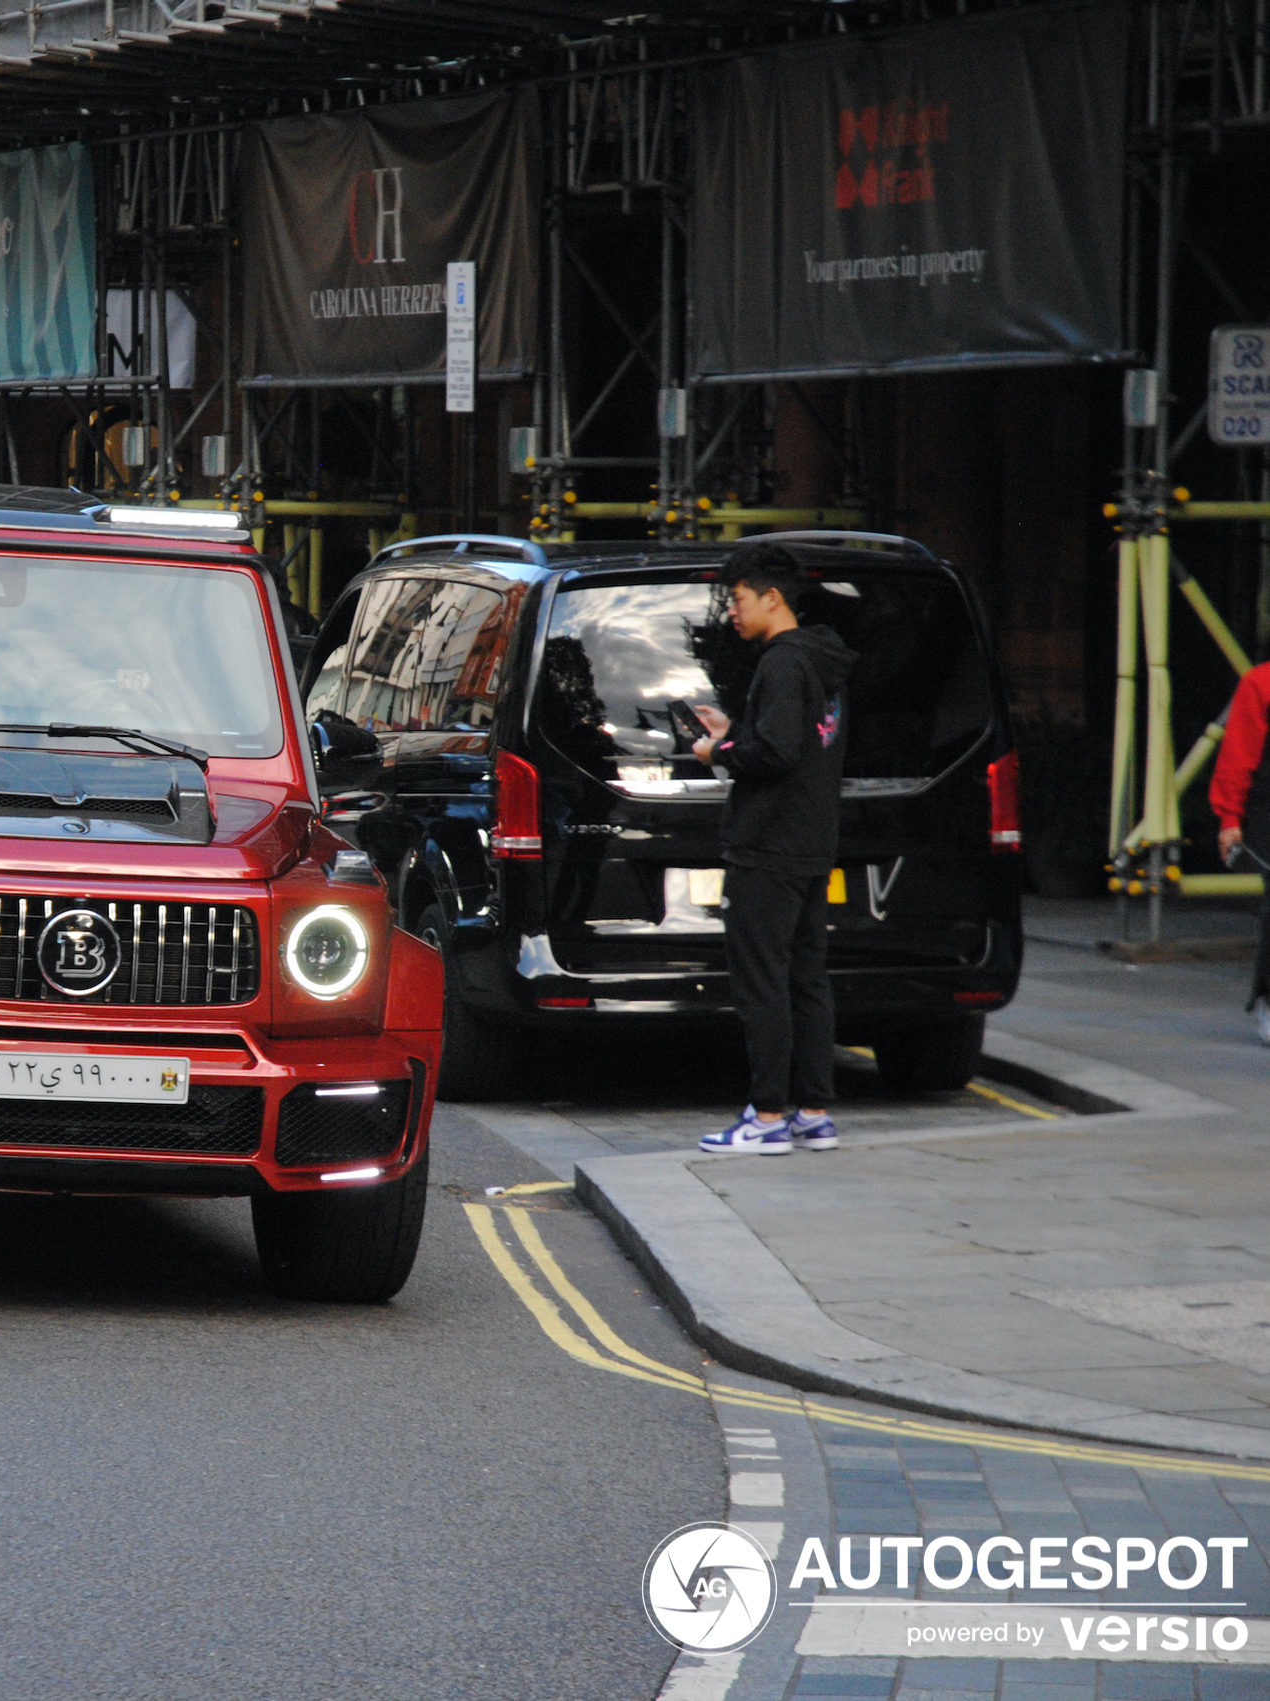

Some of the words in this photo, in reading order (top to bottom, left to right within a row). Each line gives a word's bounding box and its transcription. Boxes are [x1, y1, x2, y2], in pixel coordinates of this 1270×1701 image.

[348, 167, 406, 264] CH
[901, 245, 919, 276] in
[920, 249, 985, 286] property
[310, 285, 378, 318] CAROLINA
[1224, 374, 1270, 396] SCA
